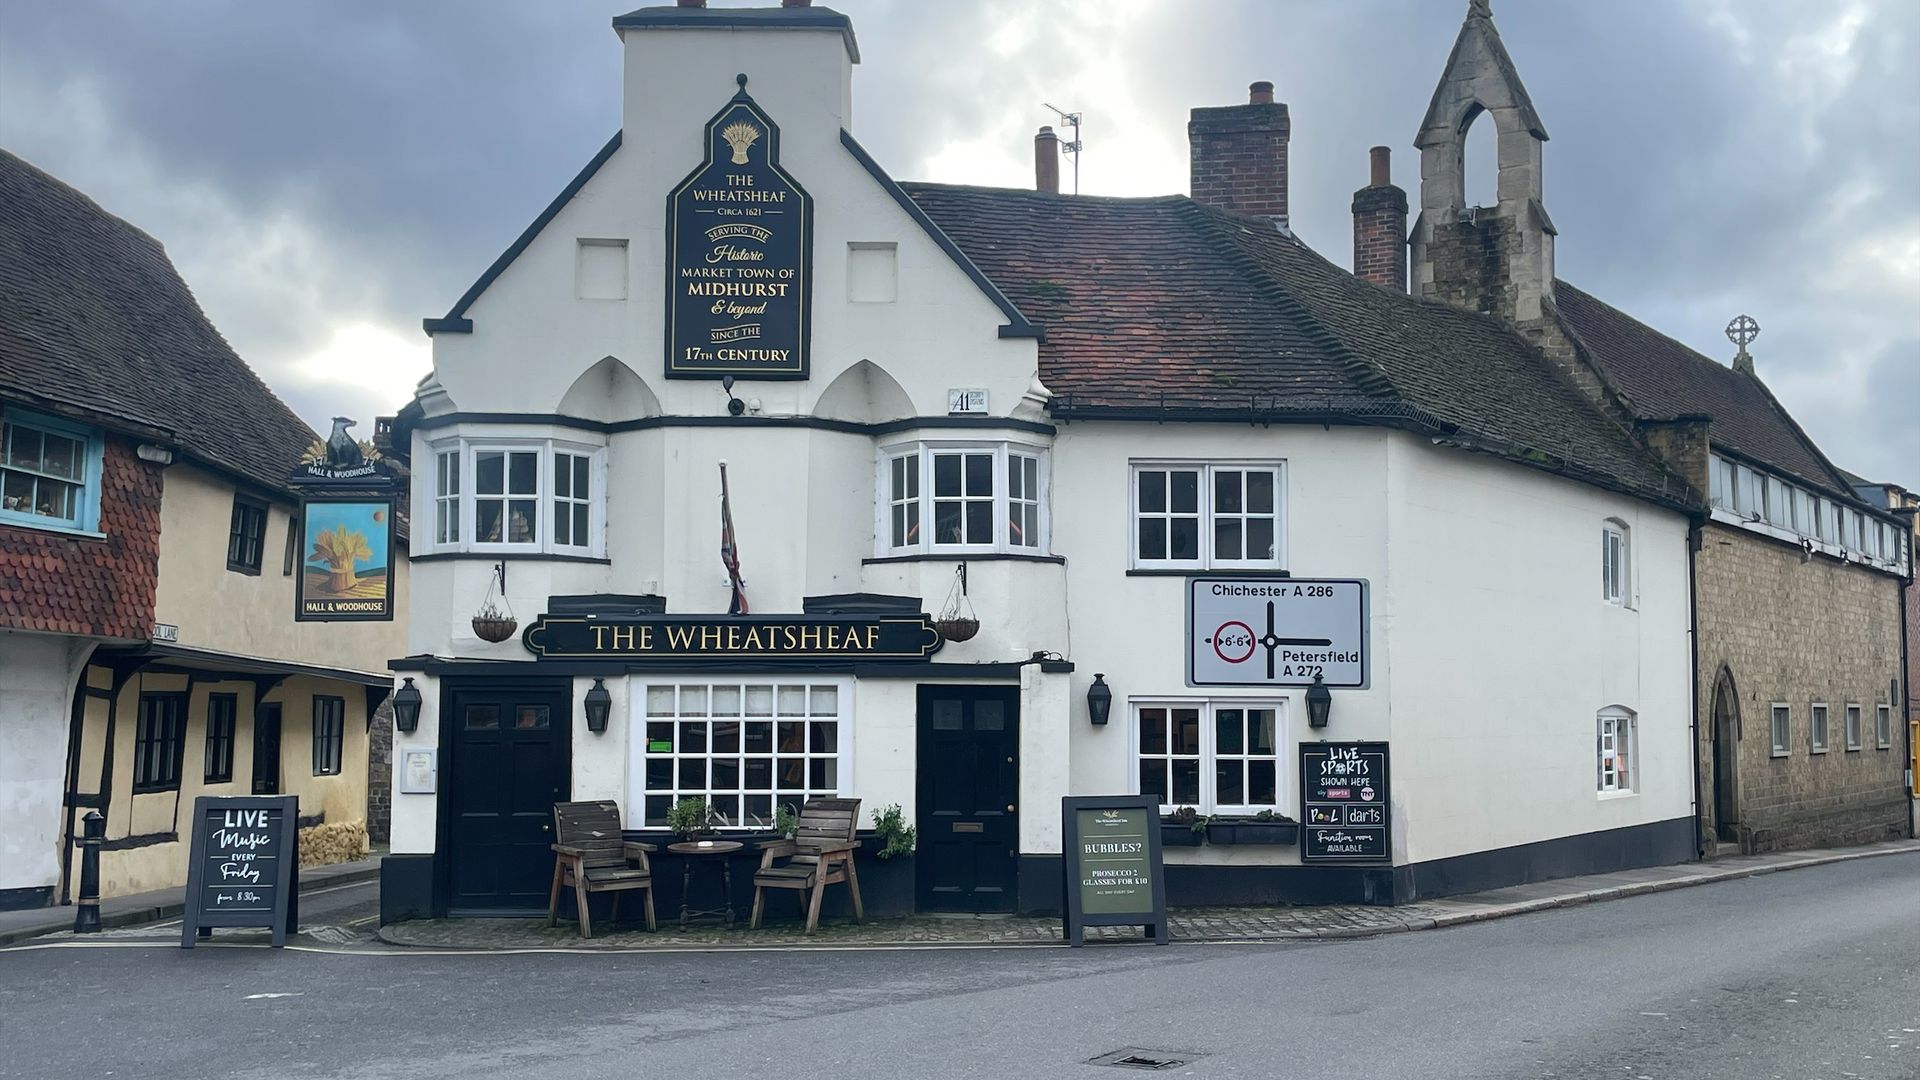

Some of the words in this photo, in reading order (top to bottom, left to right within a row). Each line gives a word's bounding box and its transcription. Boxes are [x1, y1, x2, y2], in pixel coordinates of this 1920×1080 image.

[726, 175, 753, 186] THE
[693, 190, 786, 202] WHEATSHEAF
[745, 207, 761, 216] 1621
[708, 226, 749, 241] SERVING
[751, 228, 769, 241] THE
[706, 246, 764, 263] Historic
[682, 268, 731, 278] MARKET
[737, 268, 774, 278] TOWN
[779, 269, 795, 279] OF
[688, 283, 788, 296] MIDHURST
[711, 300, 725, 314] &
[728, 301, 767, 318] beyond
[711, 329, 738, 340] SINCE
[742, 327, 760, 337] THE
[717, 349, 790, 361] CENTURY
[953, 392, 969, 411] A1
[313, 456, 323, 467] 17
[363, 456, 375, 466] 77
[308, 466, 324, 476] HALL
[334, 466, 376, 478] WOODHOUSE
[1212, 585, 1286, 597] Chichester
[1294, 585, 1303, 597] A
[1308, 586, 1333, 597] 286
[306, 603, 325, 612] HALL
[327, 603, 334, 611] &
[336, 602, 382, 611] WOODHOUSE
[590, 625, 653, 650] THE
[664, 625, 880, 650] WHEATSHEAF
[1283, 651, 1358, 663] Petersfield
[1283, 666, 1293, 676] A
[1297, 666, 1323, 677] 272
[1330, 747, 1359, 760] LIVE
[1321, 760, 1369, 775] SPORTS
[1321, 778, 1347, 786] SHOWN
[1350, 778, 1370, 786] HERE
[224, 810, 268, 828] LIVE
[1350, 808, 1380, 822] darts
[212, 829, 270, 850] Music
[1317, 830, 1353, 843] Function
[1085, 843, 1142, 853] BUBBLES?
[221, 863, 260, 883] Friday
[1135, 877, 1148, 885] £10
